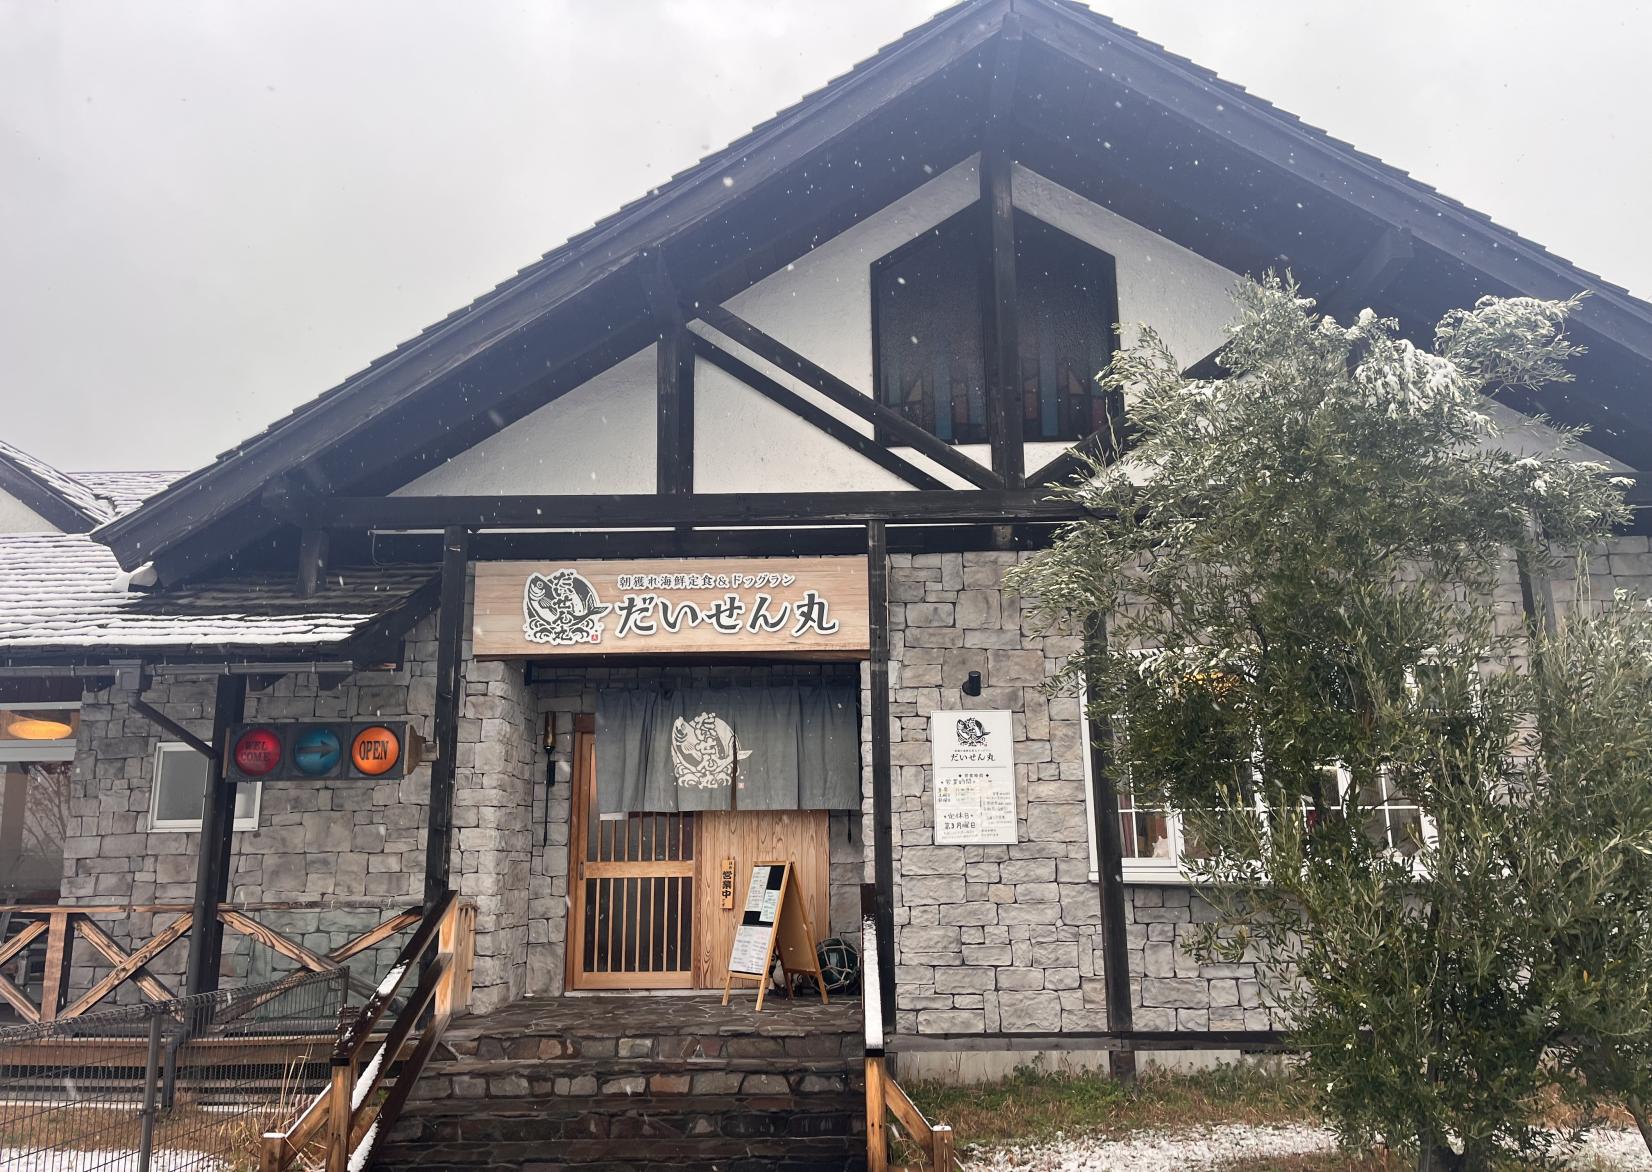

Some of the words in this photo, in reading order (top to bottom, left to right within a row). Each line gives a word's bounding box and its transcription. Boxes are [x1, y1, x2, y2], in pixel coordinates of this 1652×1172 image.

[619, 574, 794, 588] 朝獲れ海鮮定食&ドッグラン
[618, 593, 836, 635] だいせん丸
[244, 741, 268, 751] WEL
[359, 740, 389, 760] OPEN
[240, 751, 271, 762] COME
[951, 753, 996, 762] だいせん丸
[722, 870, 732, 898] 営業中
